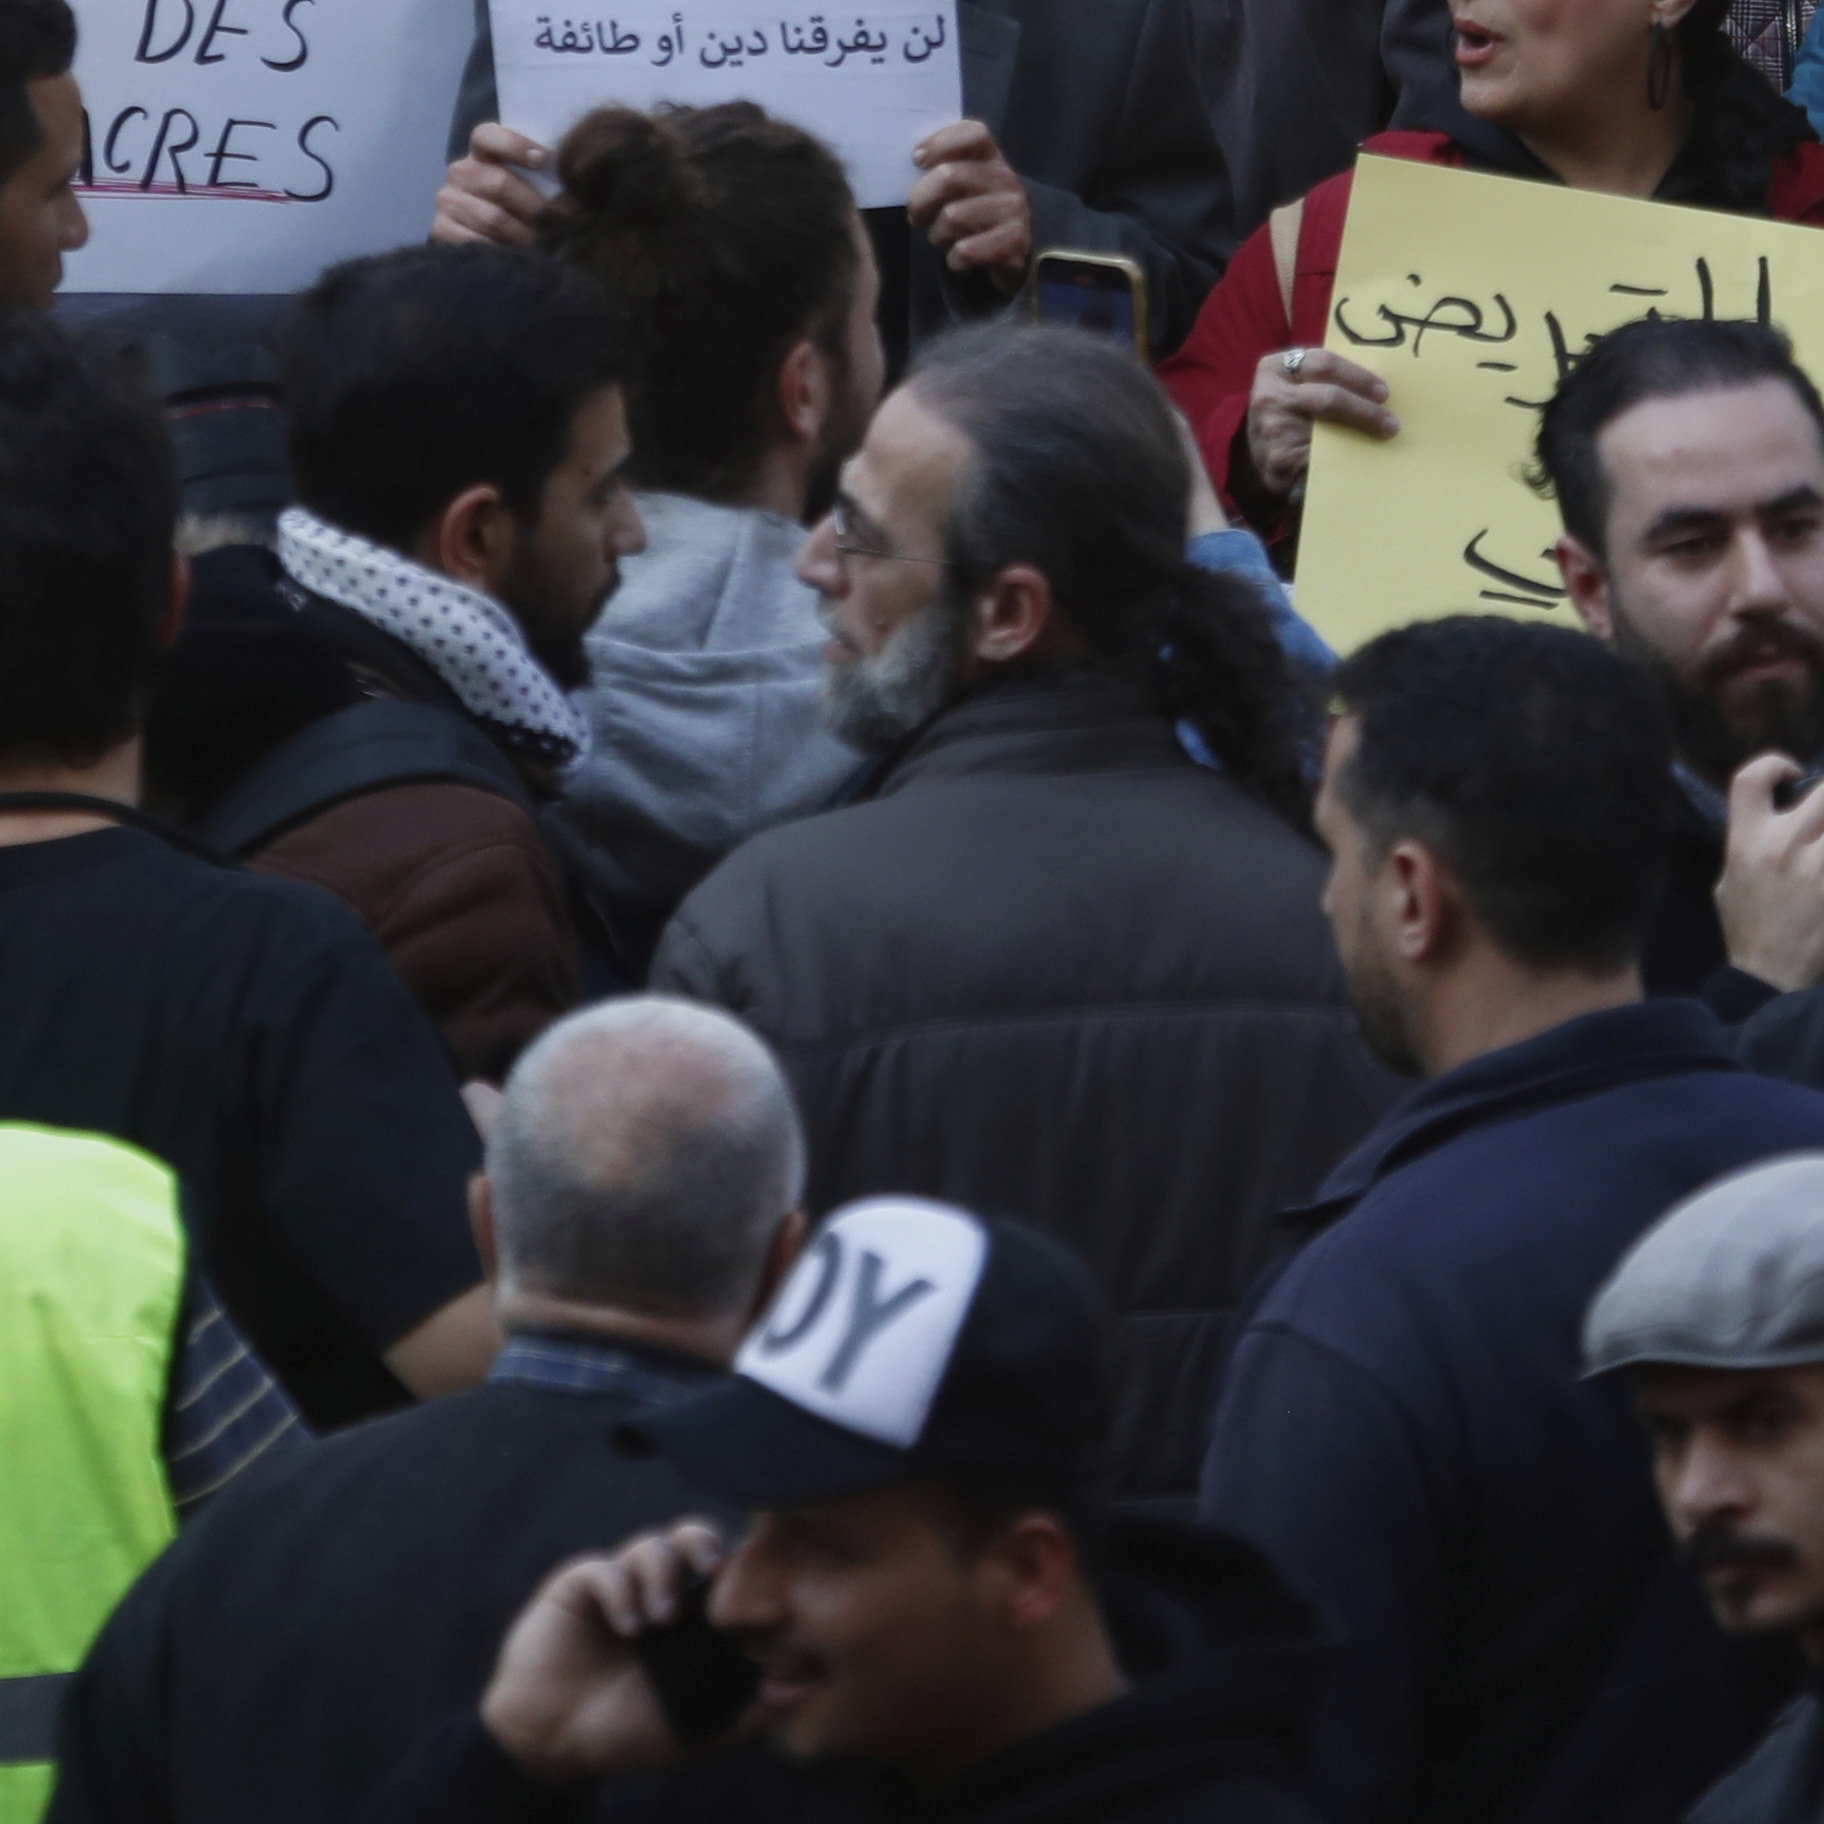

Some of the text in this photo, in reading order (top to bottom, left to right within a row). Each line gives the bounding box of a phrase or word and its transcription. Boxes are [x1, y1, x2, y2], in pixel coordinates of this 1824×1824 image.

[534, 13, 945, 67] لن يفرقنا دين أو طائفة
